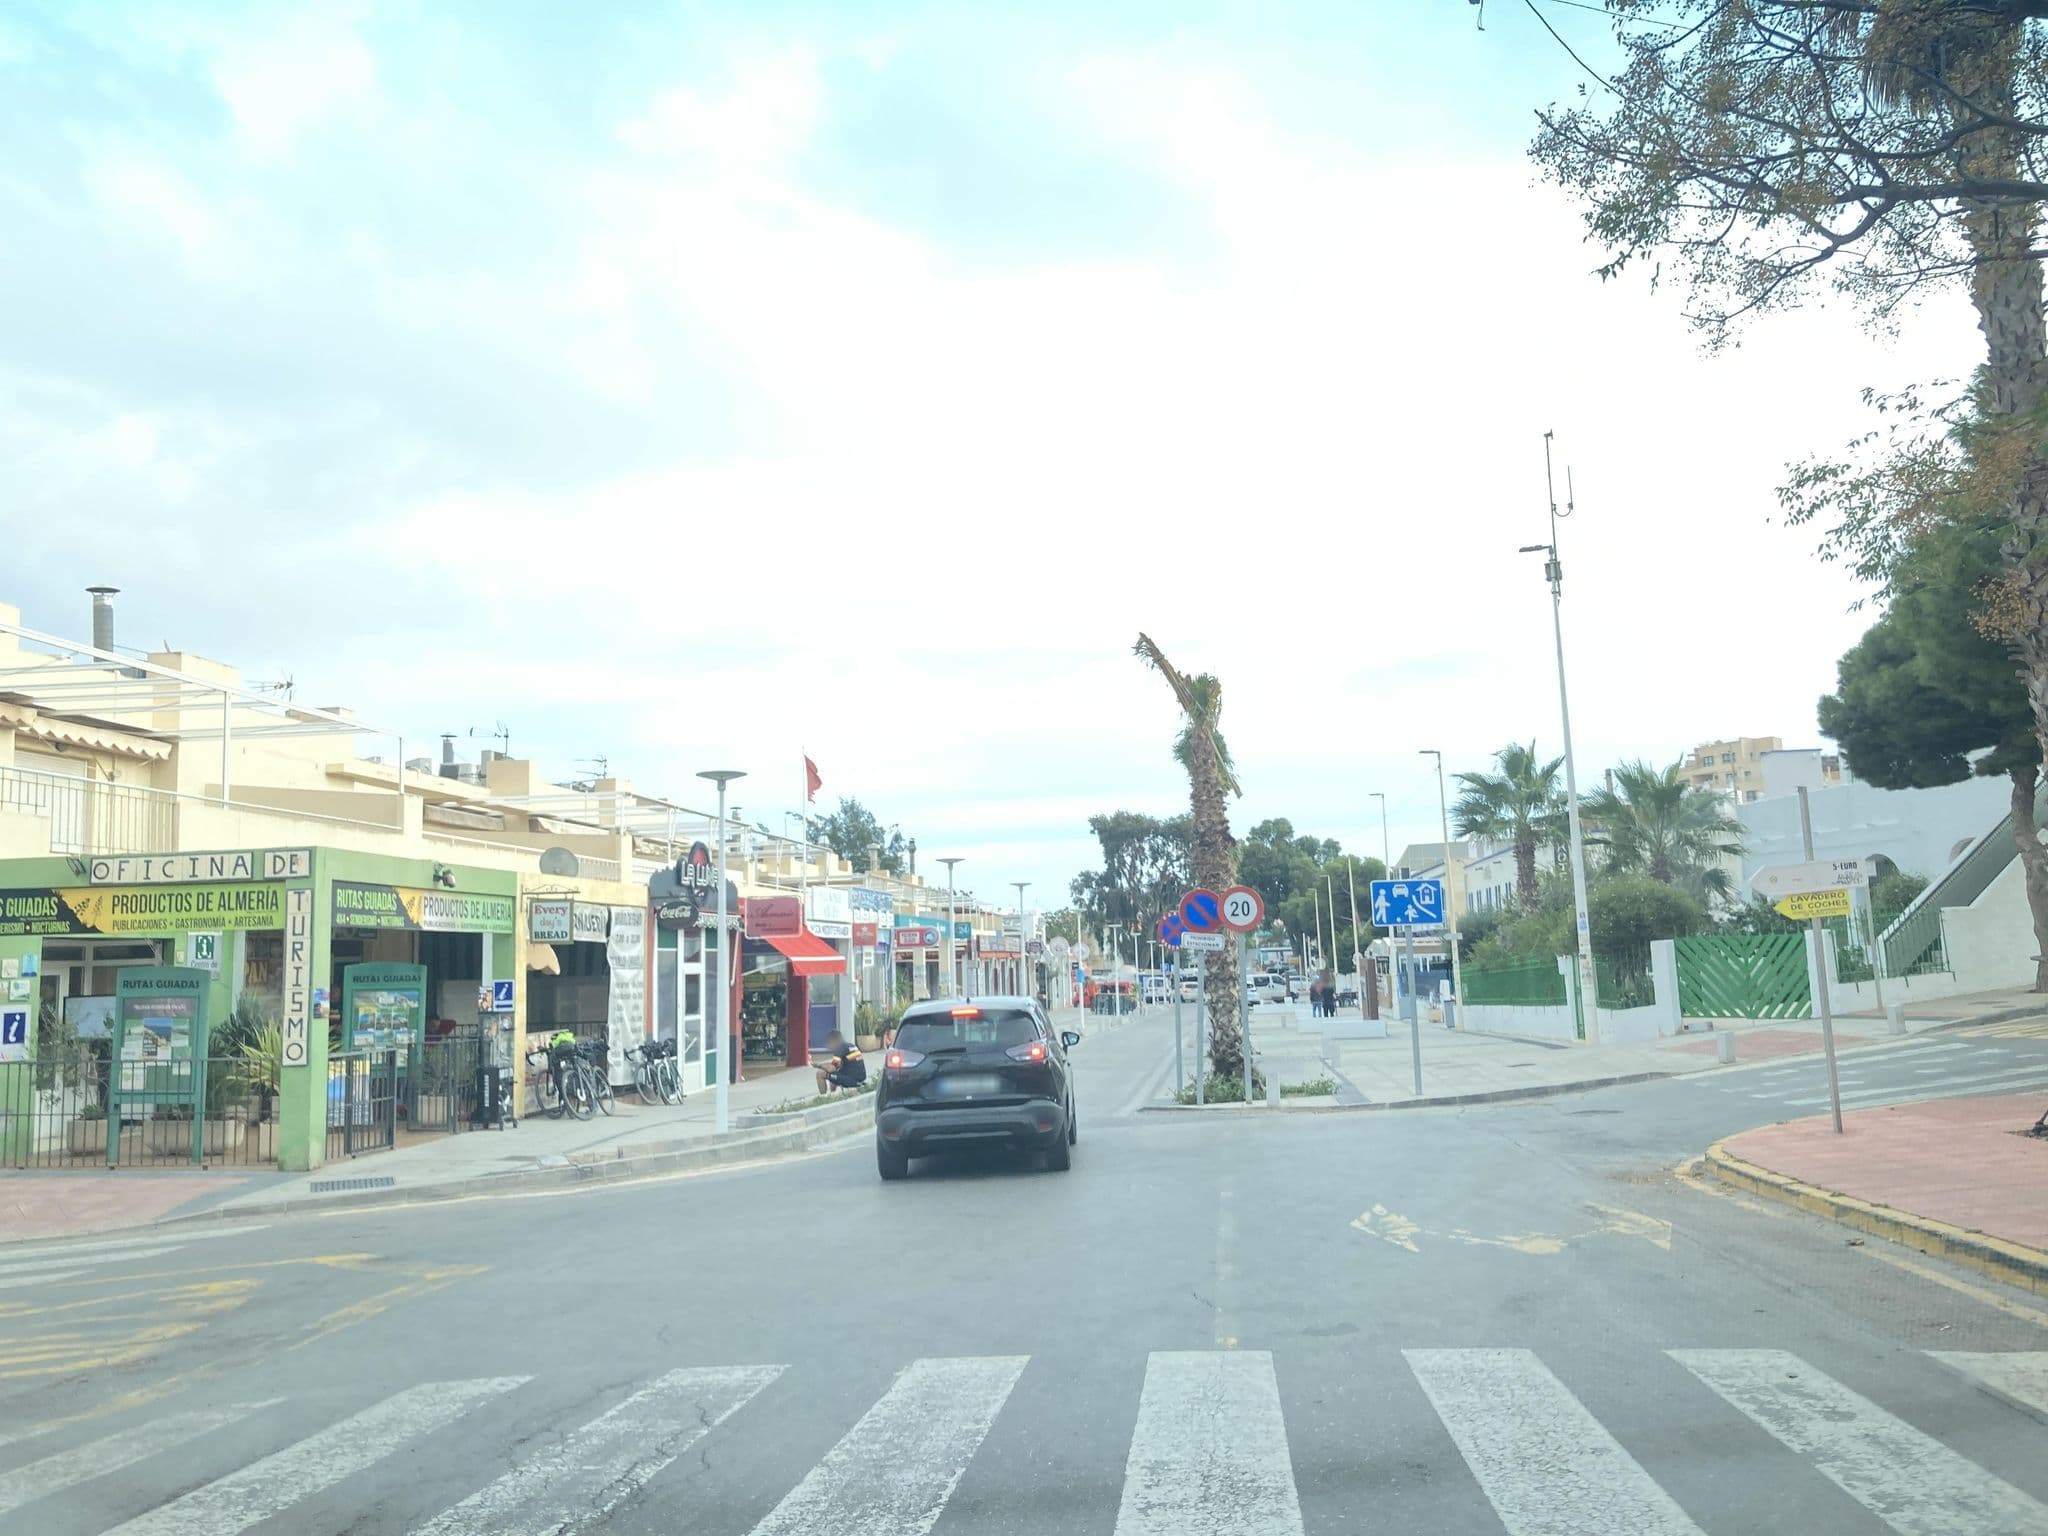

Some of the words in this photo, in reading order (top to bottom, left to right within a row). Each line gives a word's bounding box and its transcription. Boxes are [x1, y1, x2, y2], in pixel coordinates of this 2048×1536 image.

[93, 855, 250, 881] OFICINA
[273, 853, 298, 875] DE
[112, 892, 192, 914] PRODUCTOS
[196, 891, 214, 912] DE
[218, 886, 279, 911] ALMERÍA
[336, 888, 363, 909] RUTAS
[364, 891, 397, 912] GUIADAS
[1790, 891, 1845, 903] LAVADERO
[1808, 900, 1848, 909] COCHES
[6, 896, 58, 918] GUIADAS
[423, 896, 468, 919] PRODUCTOS
[470, 900, 480, 919] DE
[534, 904, 568, 915] Every
[1230, 901, 1250, 917] 20
[112, 918, 168, 931] PUBLICACIONES
[534, 931, 568, 939] BREAD
[286, 891, 305, 1061] TURISMO
[122, 980, 153, 989] RUTAS
[156, 980, 200, 989] GUIADAS
